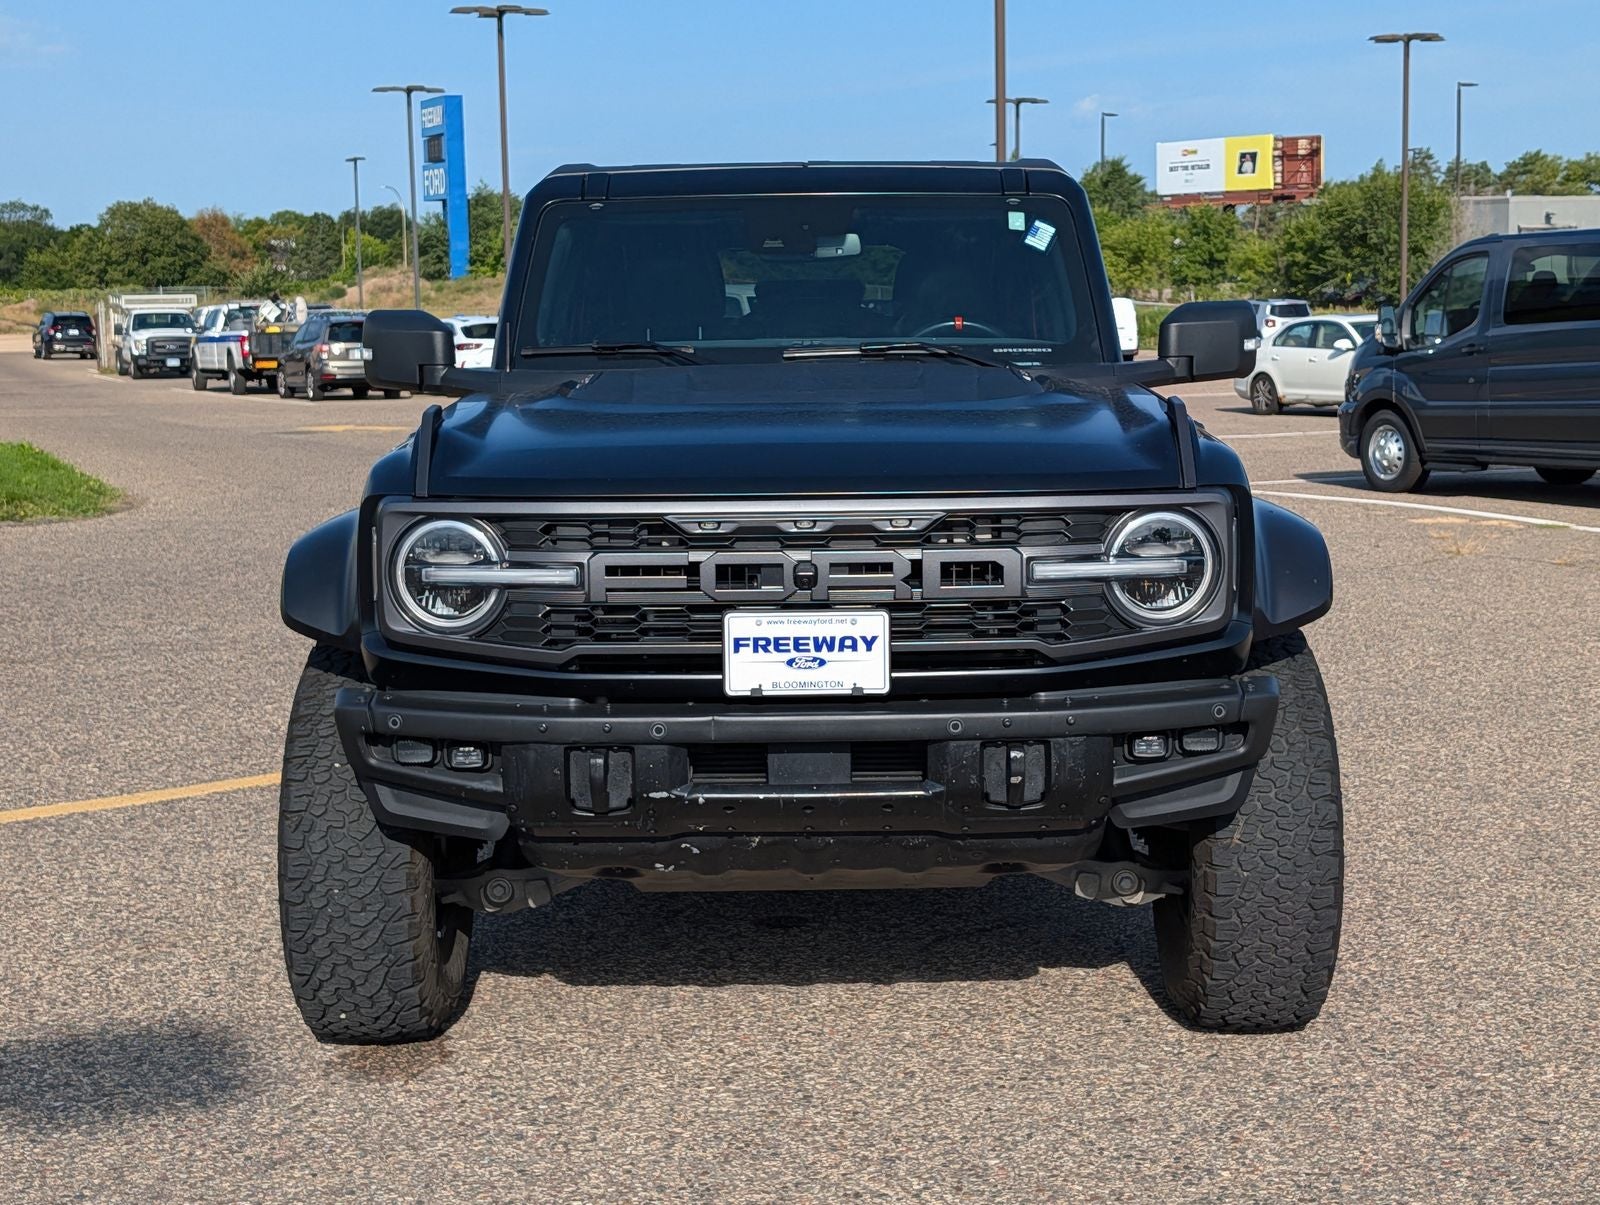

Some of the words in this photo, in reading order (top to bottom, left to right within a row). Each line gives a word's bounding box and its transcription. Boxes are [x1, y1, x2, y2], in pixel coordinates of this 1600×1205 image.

[424, 167, 446, 196] FORD
[588, 549, 1022, 601] FORD
[733, 635, 879, 654] FREEWAY
[791, 656, 820, 669] Ford
[771, 680, 844, 689] BLOOMINGTON
